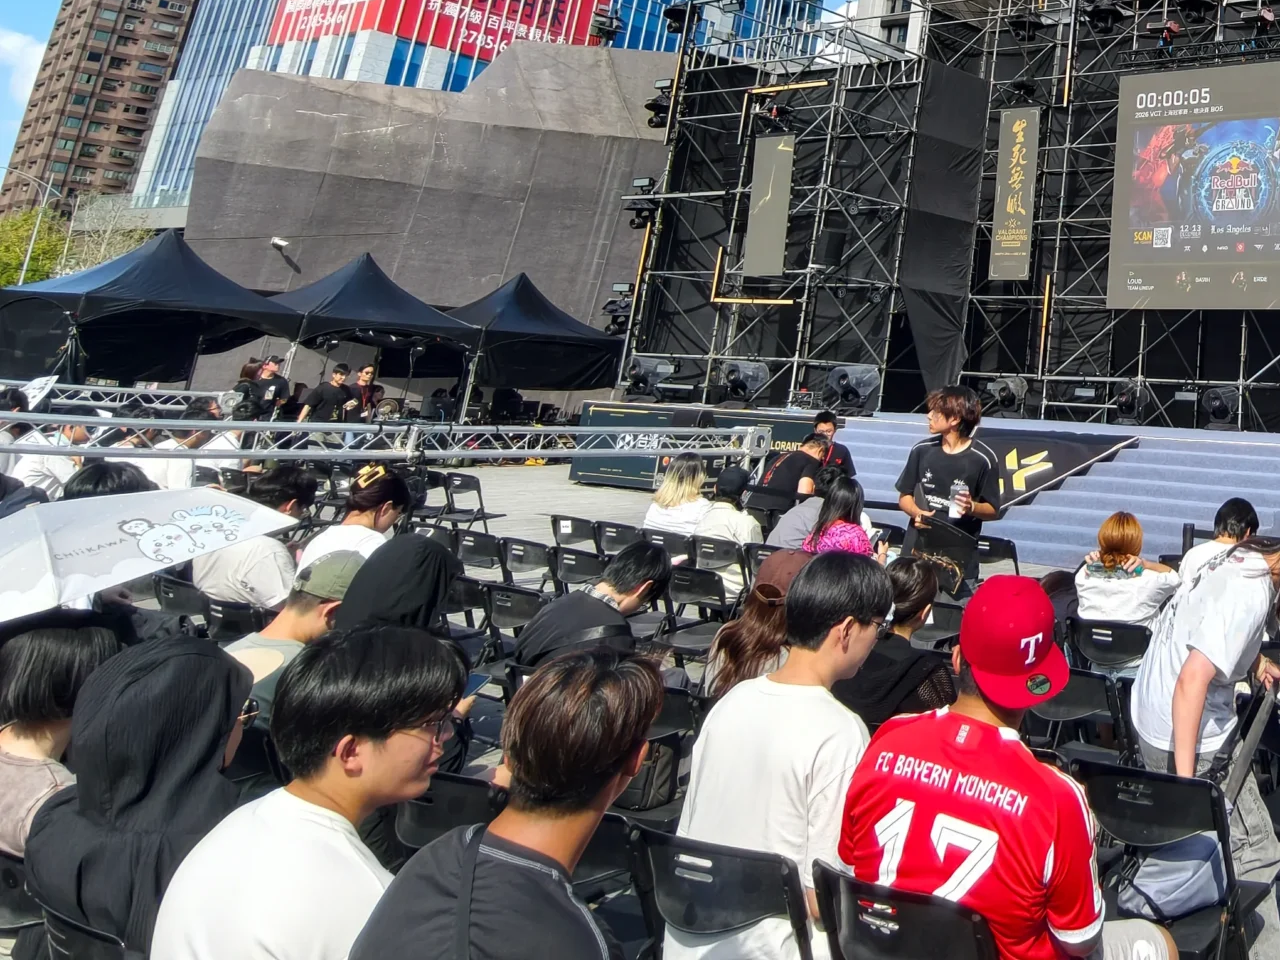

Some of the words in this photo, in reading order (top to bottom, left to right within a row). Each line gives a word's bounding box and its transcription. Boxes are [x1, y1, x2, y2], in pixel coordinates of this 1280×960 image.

[1136, 88, 1210, 109] 00:00:05
[1212, 174, 1234, 189] Red
[1235, 173, 1257, 188] Bull
[1134, 231, 1152, 241] SCAN
[1211, 225, 1224, 234] Los
[1226, 224, 1251, 235] Angeles
[1020, 632, 1043, 665] T
[875, 751, 894, 771] FC
[893, 754, 952, 789] BAYERN
[954, 772, 1028, 816] MÜNCHEN
[874, 798, 999, 902] 17
